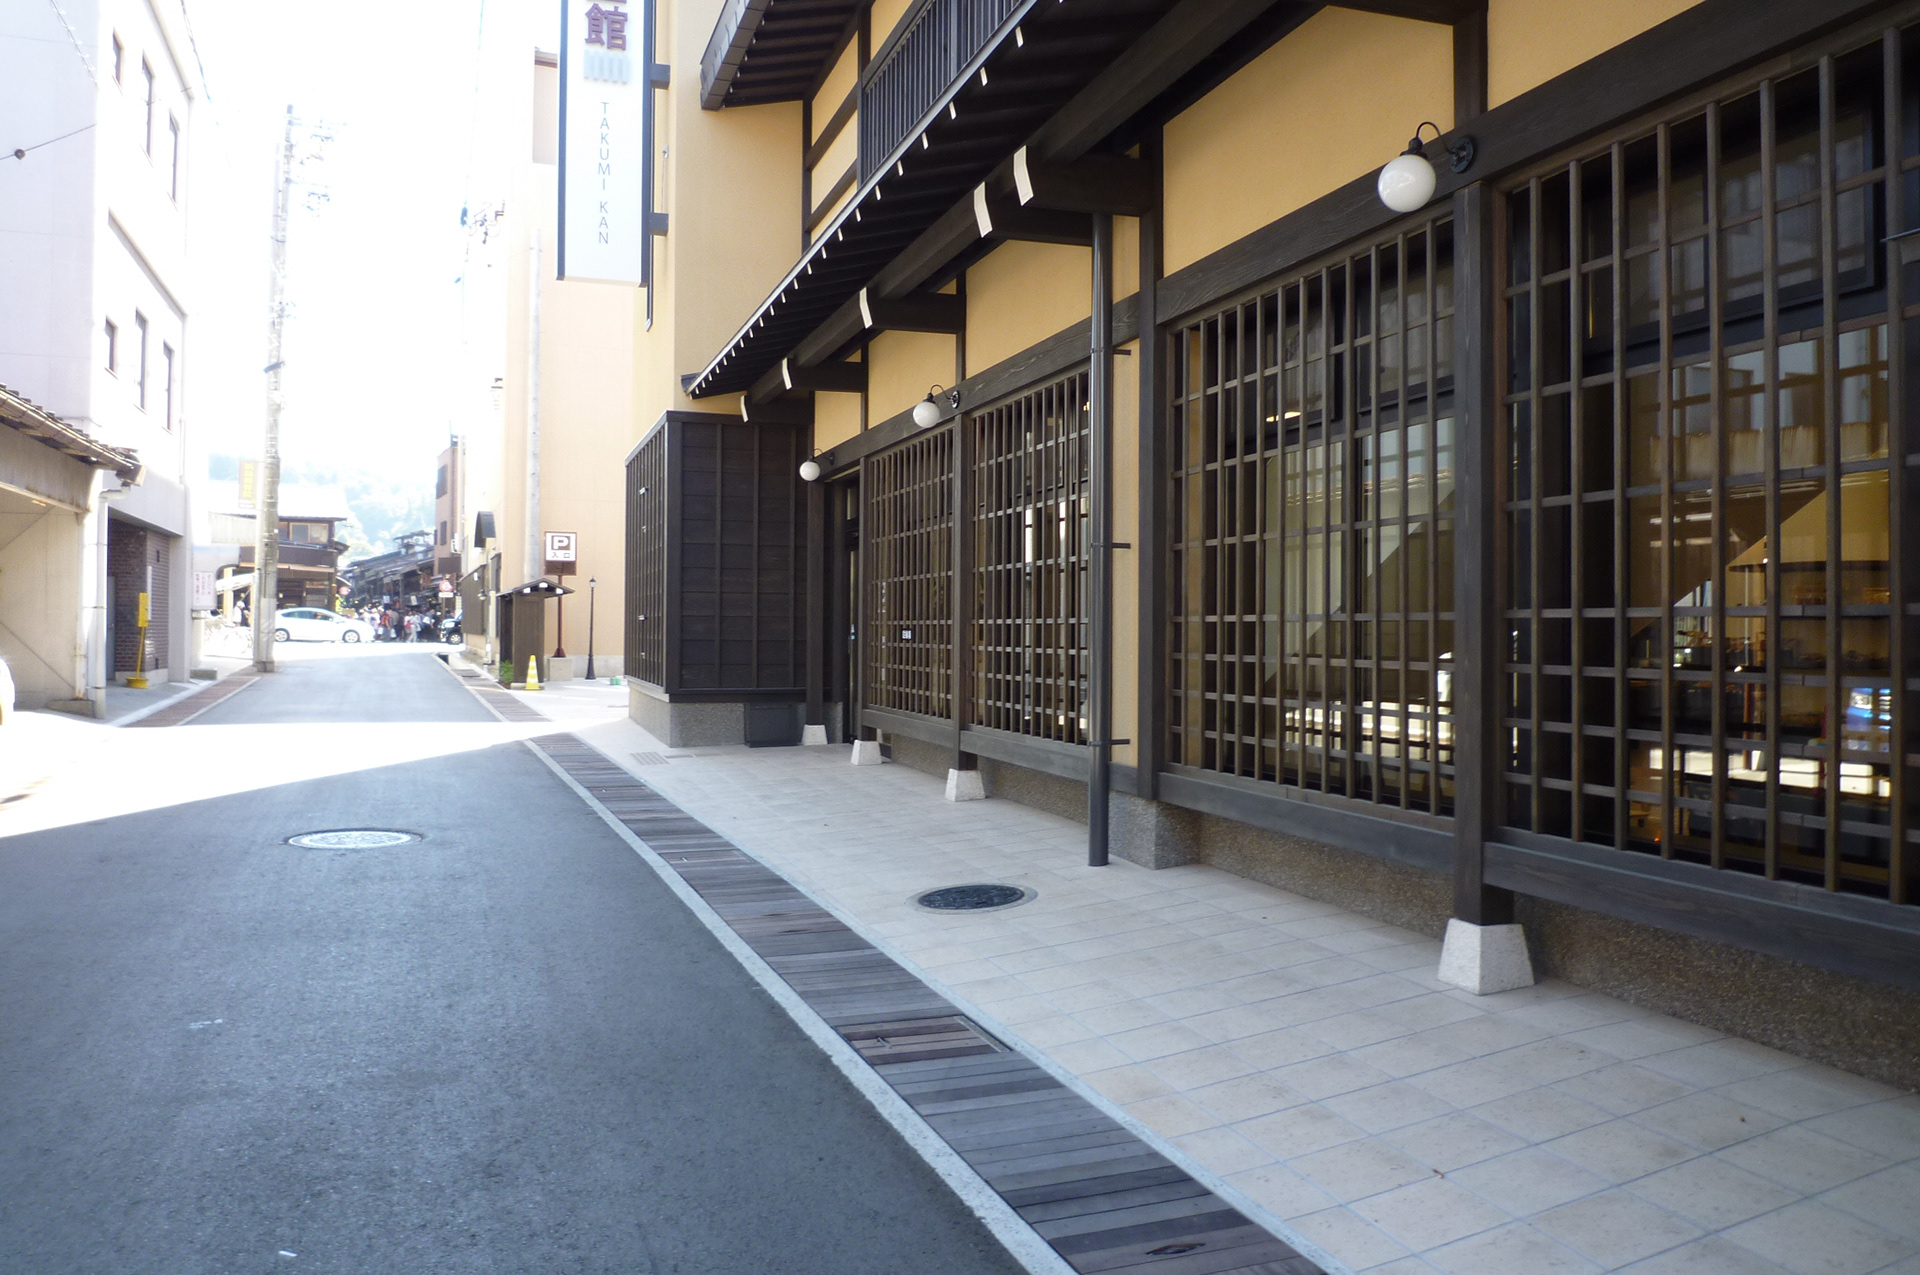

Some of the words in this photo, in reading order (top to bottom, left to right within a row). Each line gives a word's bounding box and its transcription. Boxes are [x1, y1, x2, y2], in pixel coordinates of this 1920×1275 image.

[585, 0, 628, 50] 館
[597, 102, 610, 191] TAKUMI
[598, 201, 610, 244] KAN
[553, 536, 569, 550] P
